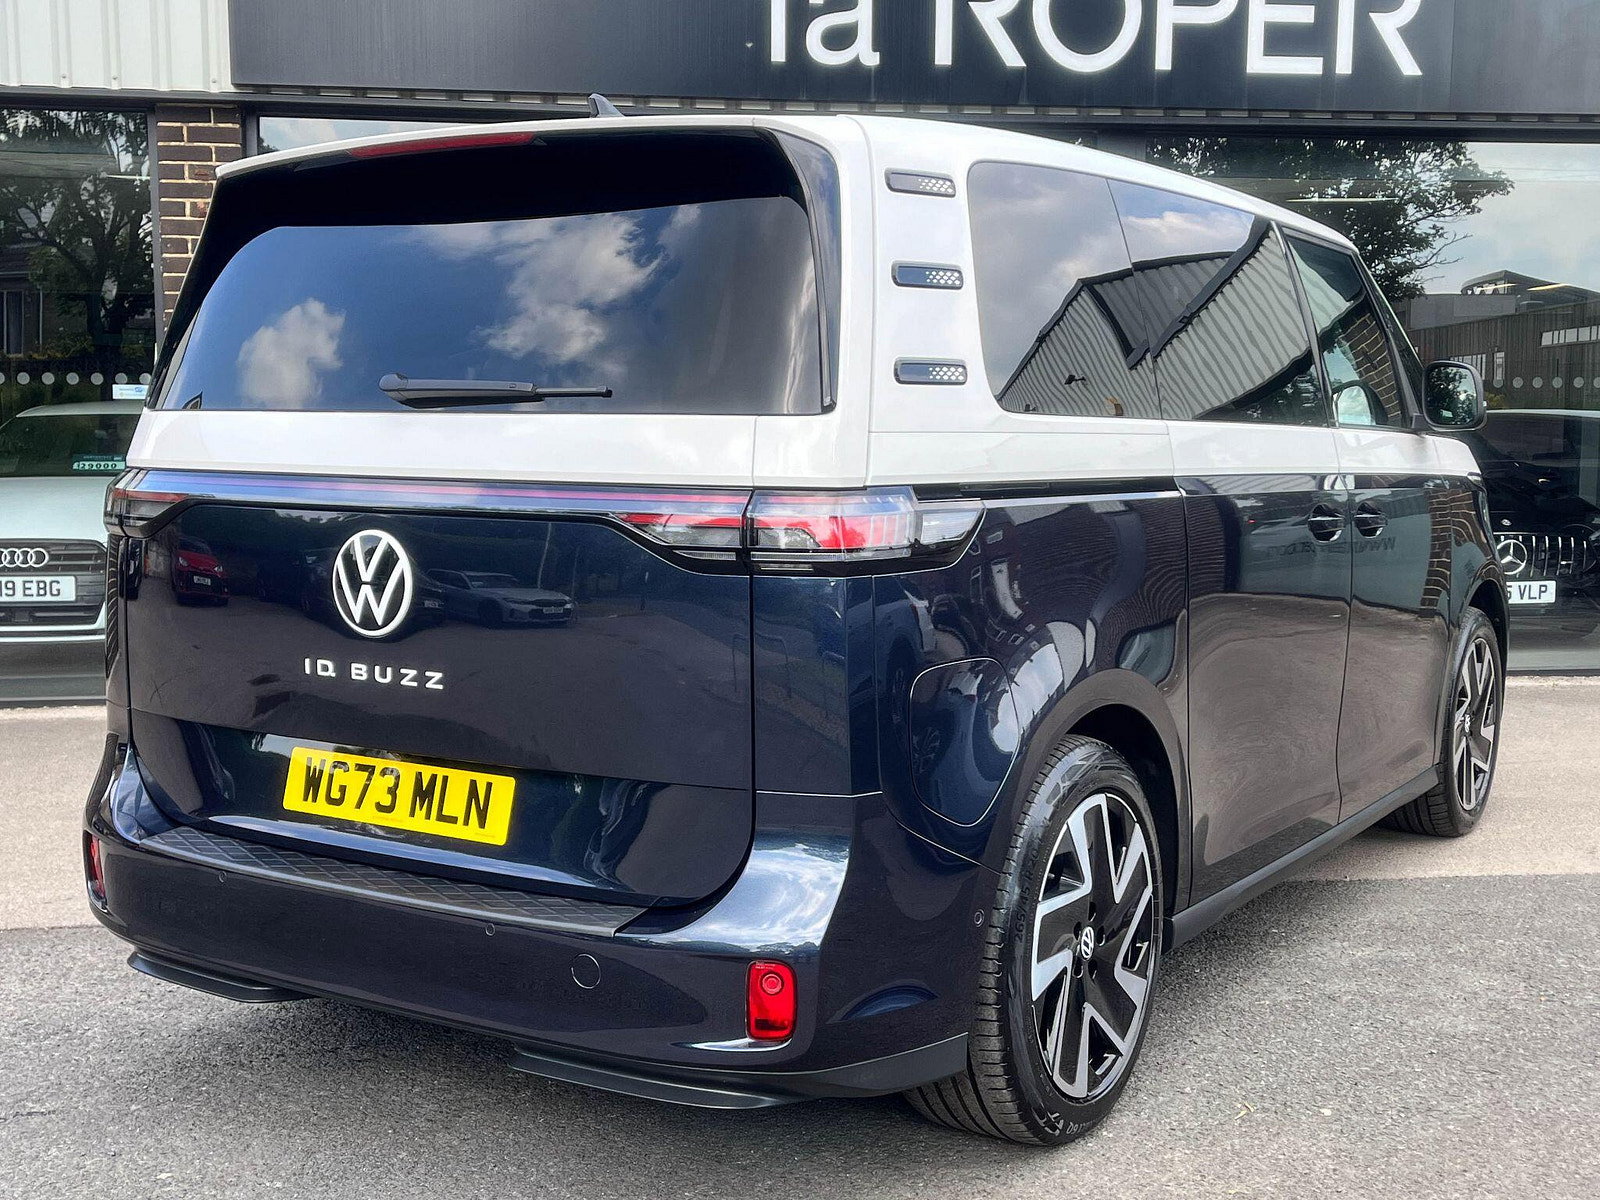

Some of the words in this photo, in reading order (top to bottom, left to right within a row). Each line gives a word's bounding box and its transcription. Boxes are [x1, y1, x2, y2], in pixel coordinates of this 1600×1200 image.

[934, 0, 1424, 76] ROPER
[22, 580, 61, 597] EBG
[1518, 584, 1548, 600] VLP
[350, 661, 444, 690] BUZZ
[302, 756, 401, 814] WG73
[408, 770, 494, 830] MLN
